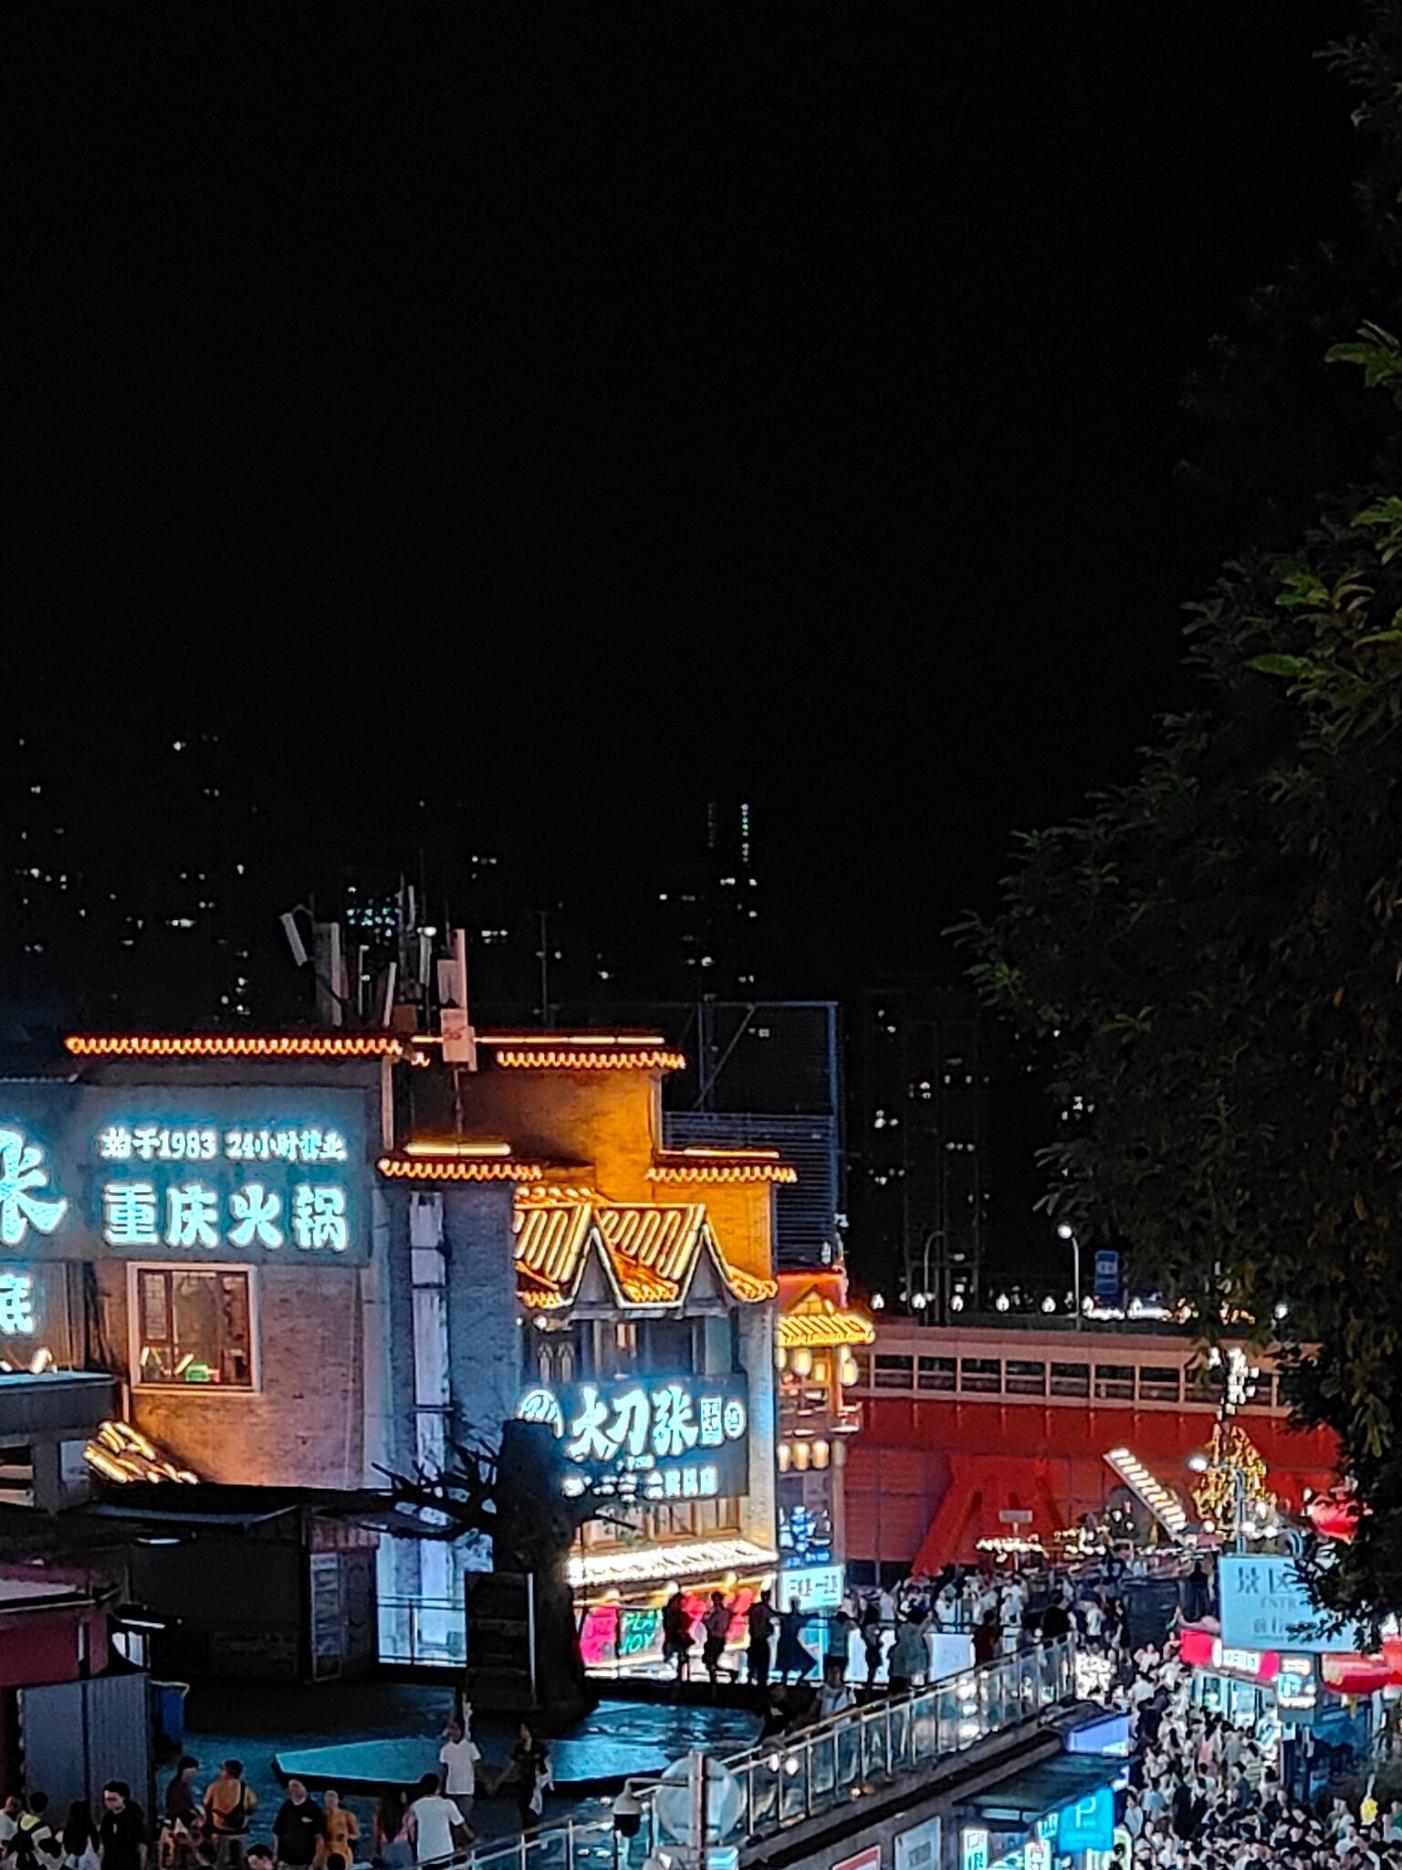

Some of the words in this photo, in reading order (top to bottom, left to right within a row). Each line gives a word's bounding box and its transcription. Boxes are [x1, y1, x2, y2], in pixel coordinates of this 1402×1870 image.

[103, 1182, 349, 1251] 重庆火锅
[564, 1385, 699, 1463] 大刀张
